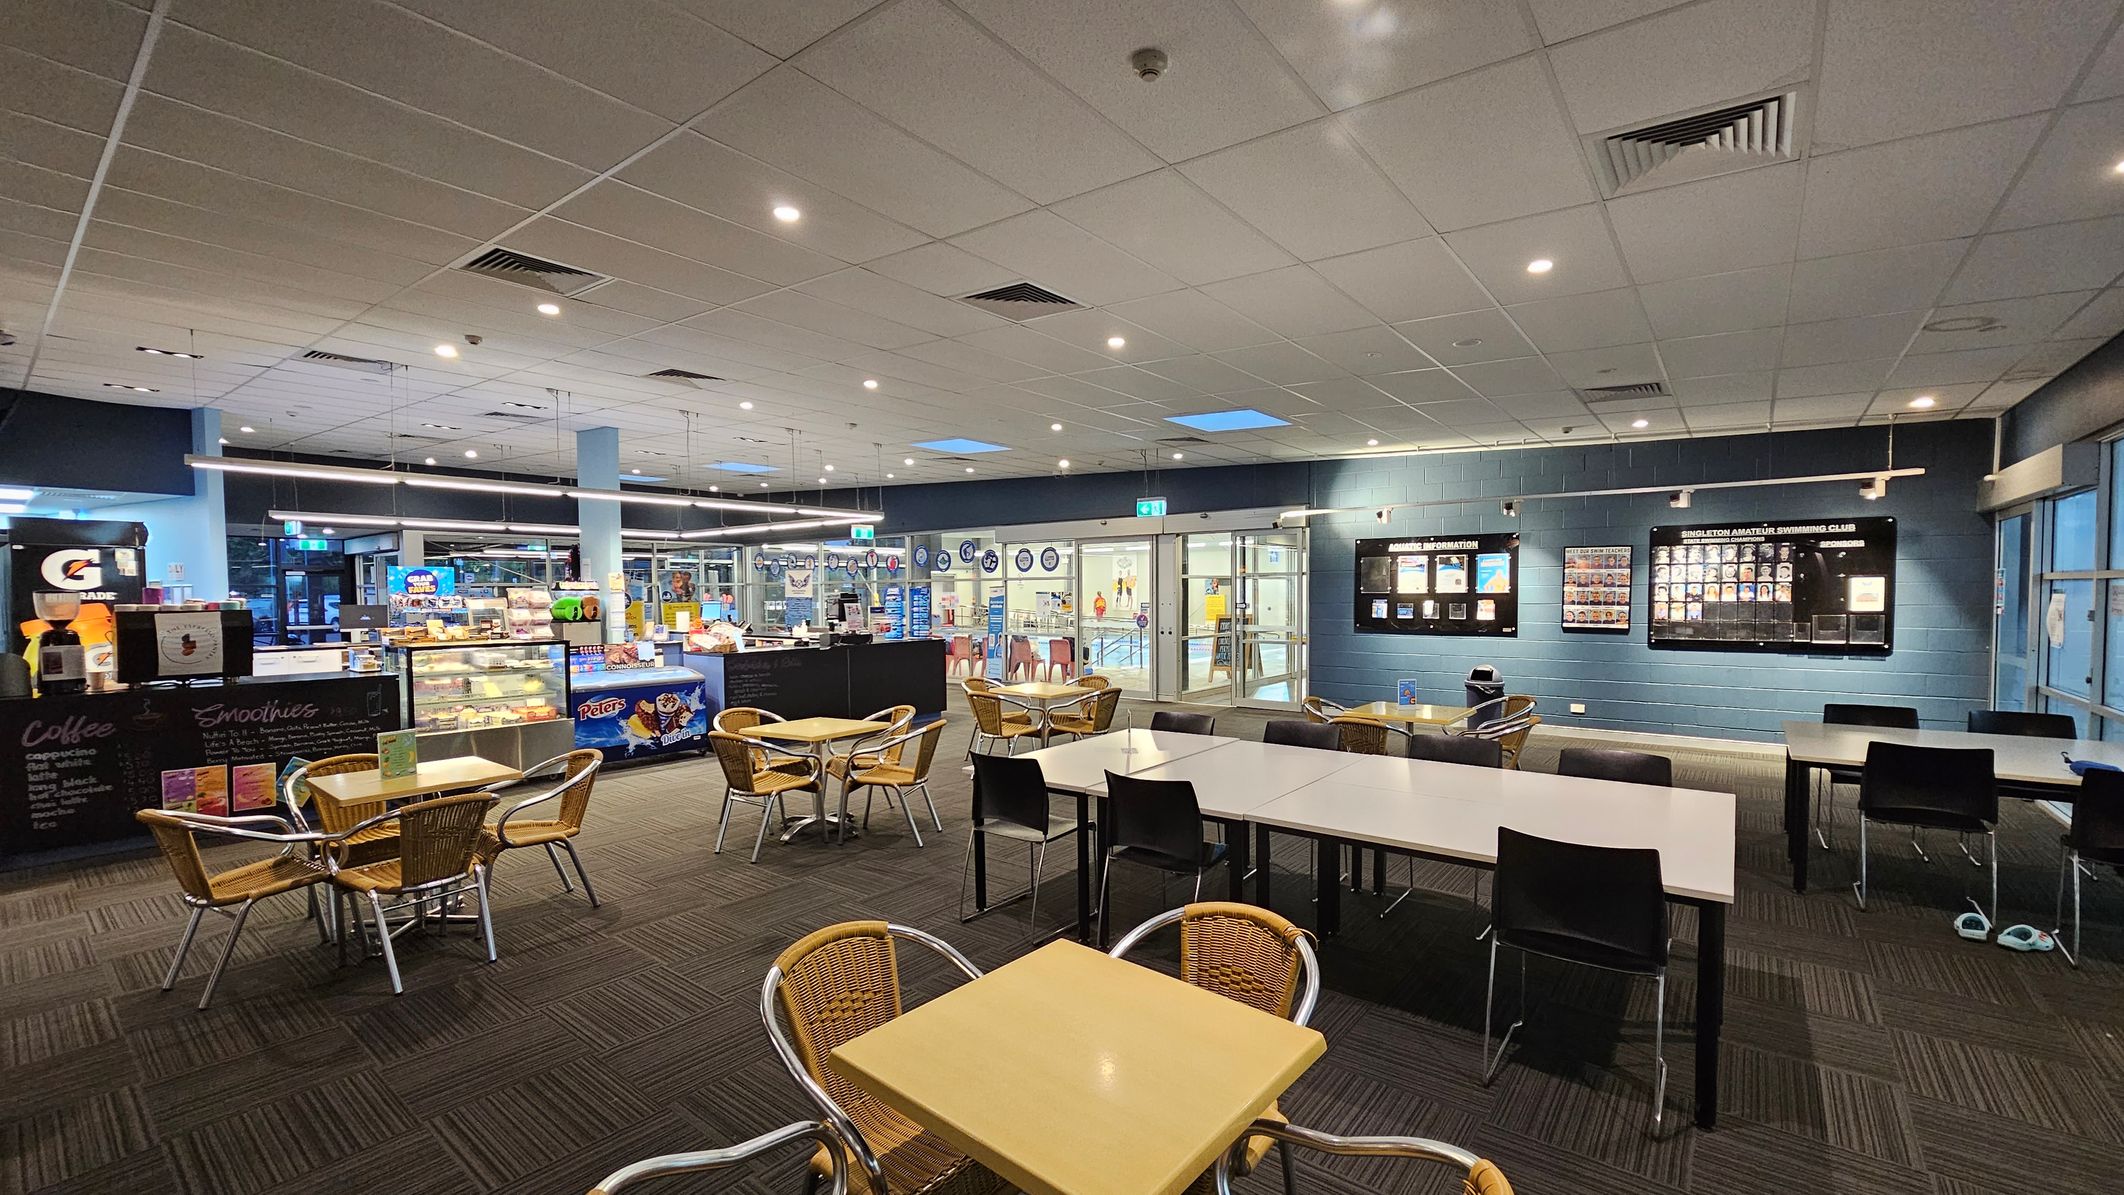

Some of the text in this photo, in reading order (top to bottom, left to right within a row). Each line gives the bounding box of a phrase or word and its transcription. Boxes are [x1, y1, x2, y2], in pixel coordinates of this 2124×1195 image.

[1681, 523, 1856, 539] SINGLETON AMATEUR SWIMMING CLUB
[1388, 541, 1479, 552] AQUATIC INFORMATION
[1820, 540, 1865, 548] SPONSORS
[407, 575, 433, 583] GRAB
[606, 661, 655, 670] CONNOISSEUR
[191, 699, 319, 728] Smoothies
[578, 698, 626, 721] Peters
[21, 715, 116, 747] Coffee
[661, 728, 691, 746] Dive in
[229, 738, 235, 746] A
[236, 738, 260, 746] Beach
[27, 771, 58, 782] latte
[28, 775, 98, 793] long black
